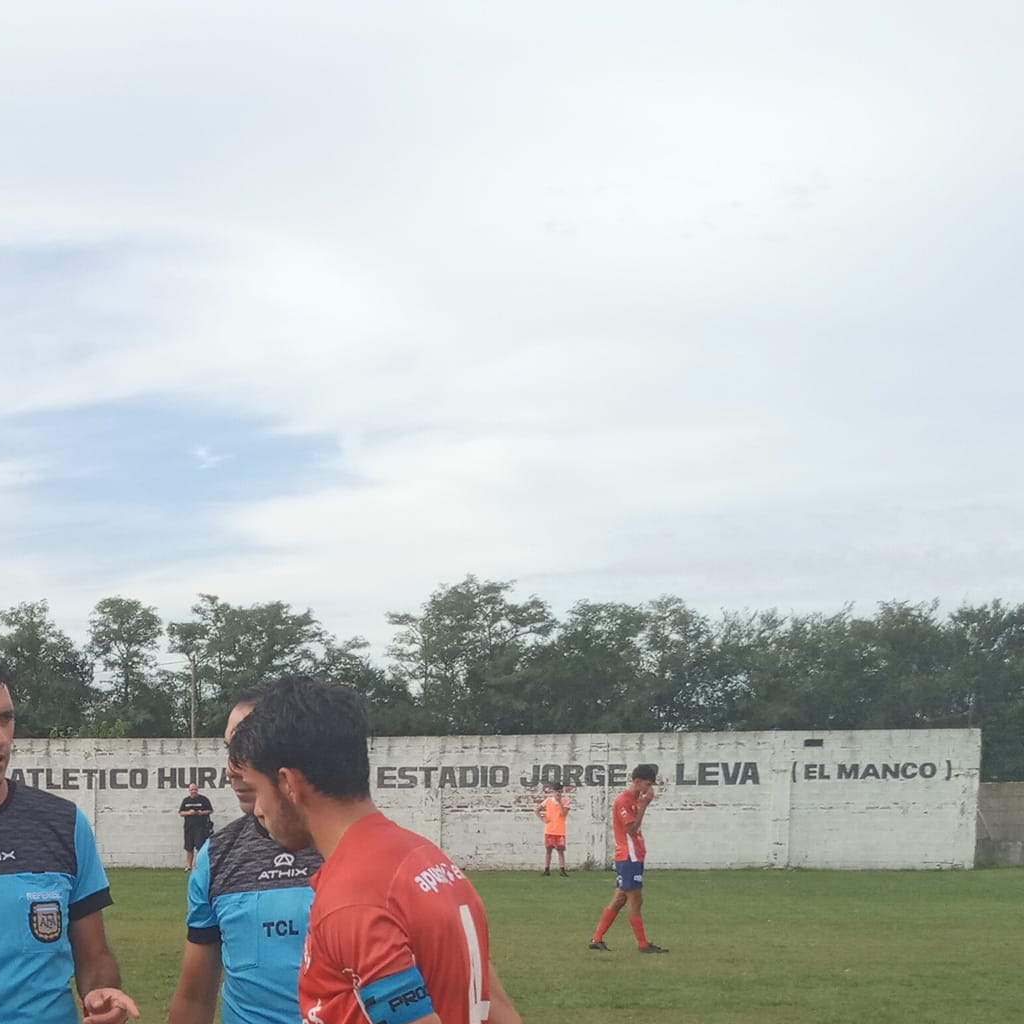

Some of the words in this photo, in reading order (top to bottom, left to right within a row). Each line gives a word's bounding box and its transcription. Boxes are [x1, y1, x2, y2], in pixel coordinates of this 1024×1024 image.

[10, 768, 148, 790] ATLETICO
[377, 765, 509, 788] ESTADIO
[520, 763, 627, 787] JORGE
[676, 762, 760, 785] LEVA
[257, 867, 309, 881] ATHIX
[262, 920, 300, 938] TCL
